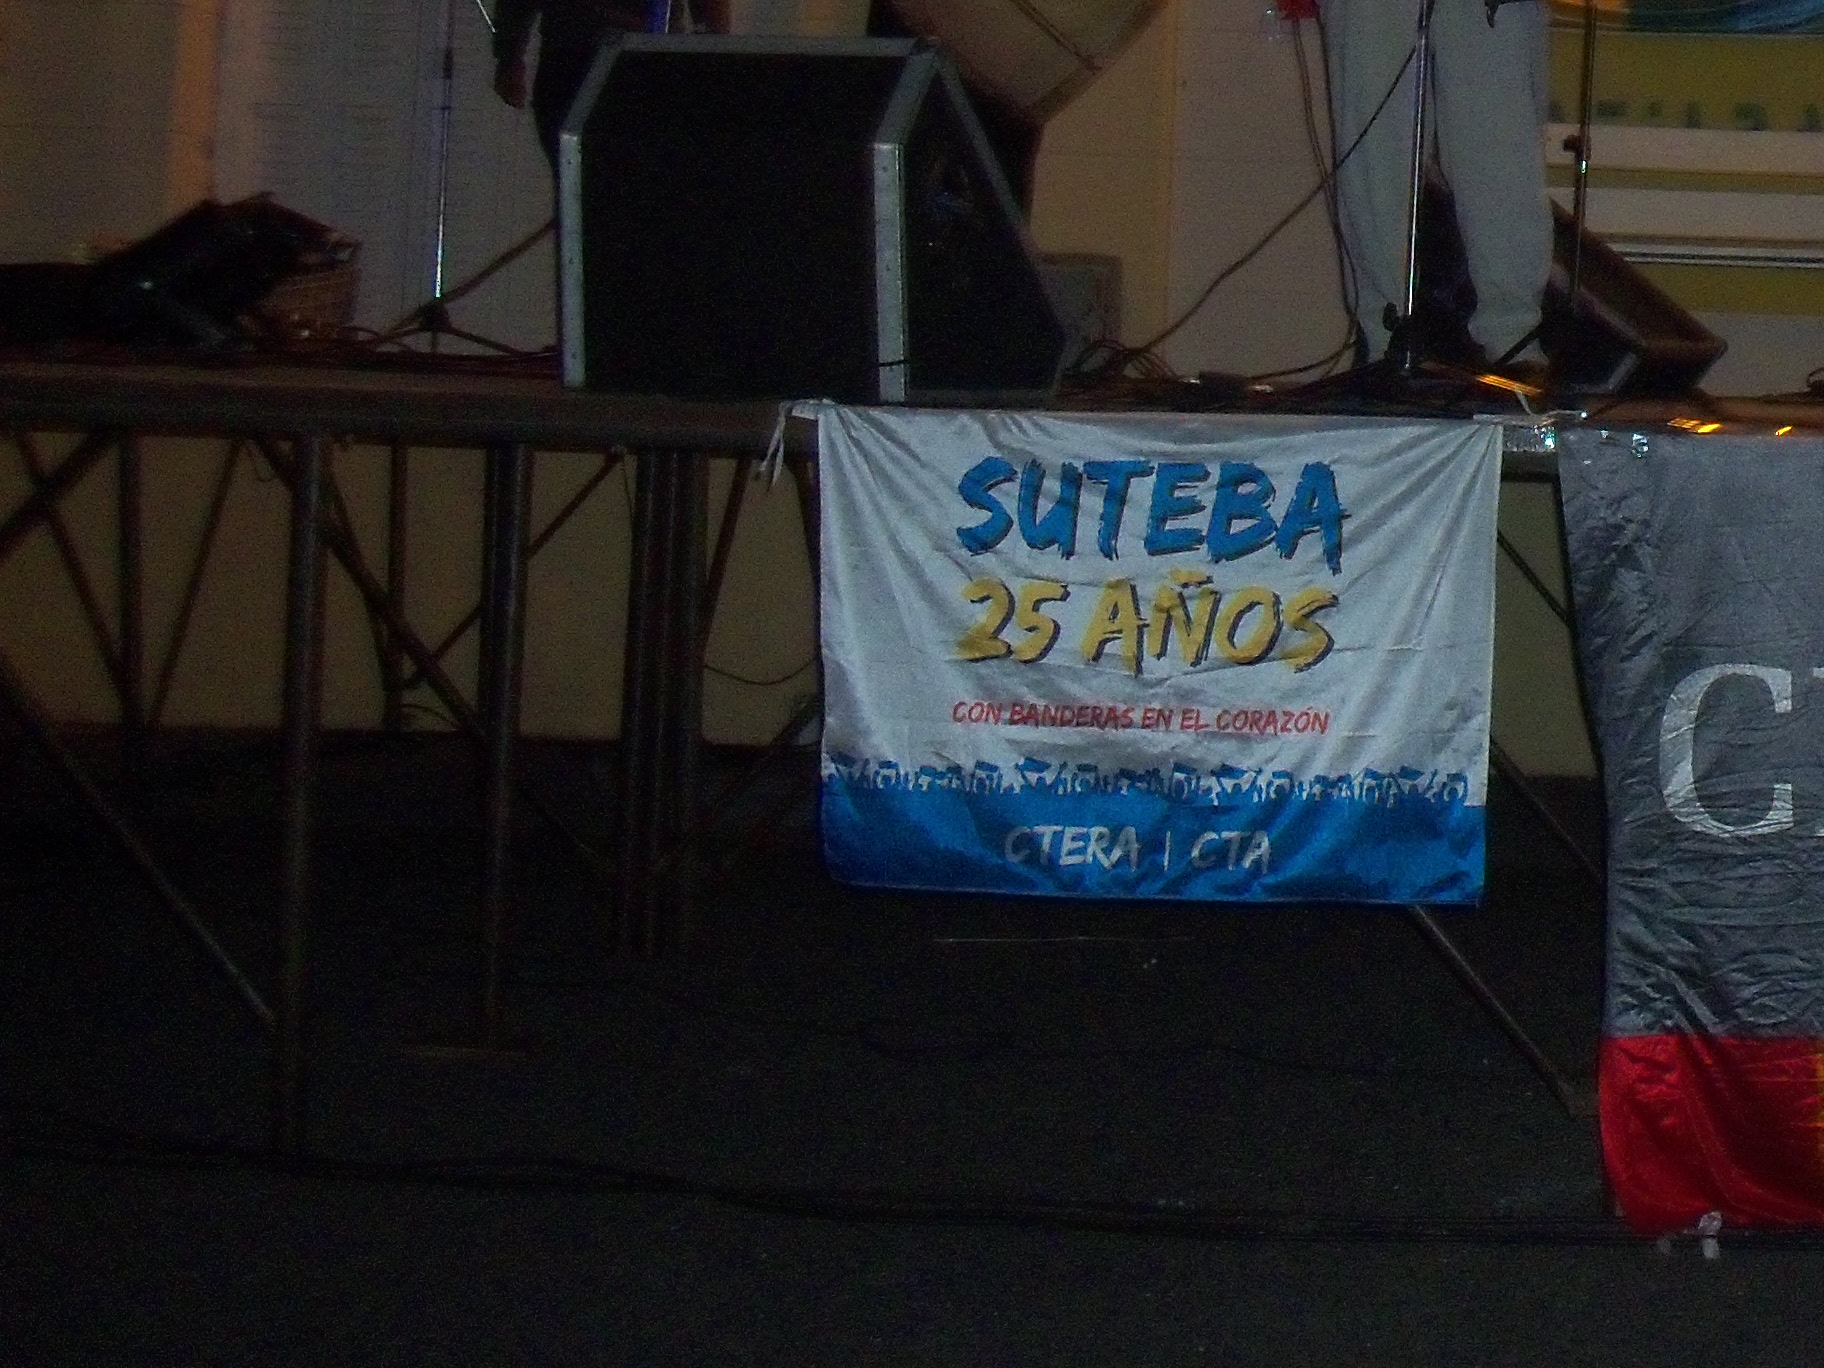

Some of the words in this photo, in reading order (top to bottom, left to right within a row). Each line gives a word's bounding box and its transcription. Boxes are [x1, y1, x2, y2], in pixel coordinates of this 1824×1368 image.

[957, 456, 1351, 575] SUTEBA
[956, 576, 1071, 663] 25
[1080, 566, 1340, 677] AÑOS
[953, 701, 1000, 725] CON
[1008, 701, 1136, 731] BANDERAS
[1141, 707, 1174, 730] EN
[1180, 707, 1210, 731] EL
[1216, 706, 1330, 735] CORAZÓN
[1004, 825, 1140, 872] CTERA
[1191, 830, 1272, 875] CTA
